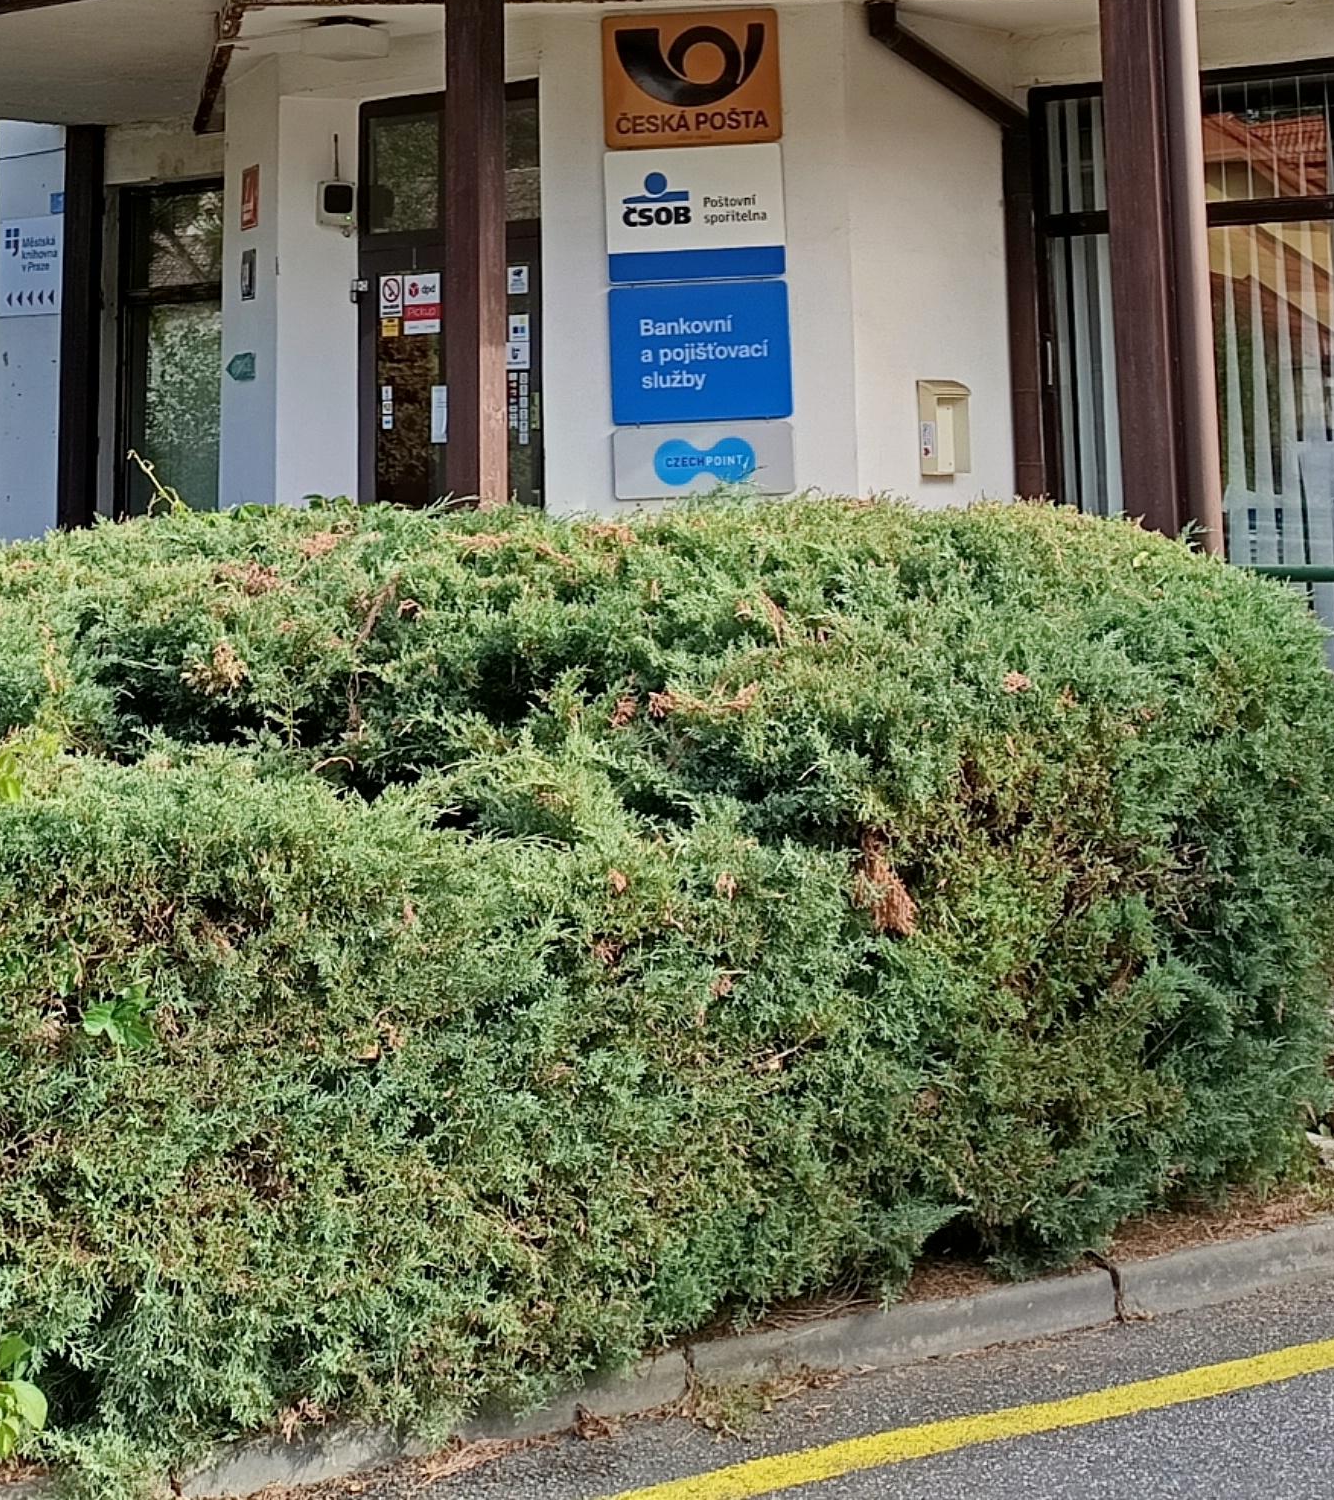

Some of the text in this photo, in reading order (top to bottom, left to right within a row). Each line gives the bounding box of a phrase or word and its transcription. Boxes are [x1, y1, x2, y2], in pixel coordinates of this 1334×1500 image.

[616, 108, 769, 134] ČESKÁ POŠTA
[703, 194, 756, 208] Poštovní
[622, 206, 692, 227] ČSOB
[703, 210, 767, 225] spořitelna
[639, 314, 733, 336] Bankovní
[640, 339, 769, 366] a pojišťovací
[641, 369, 707, 390] služby
